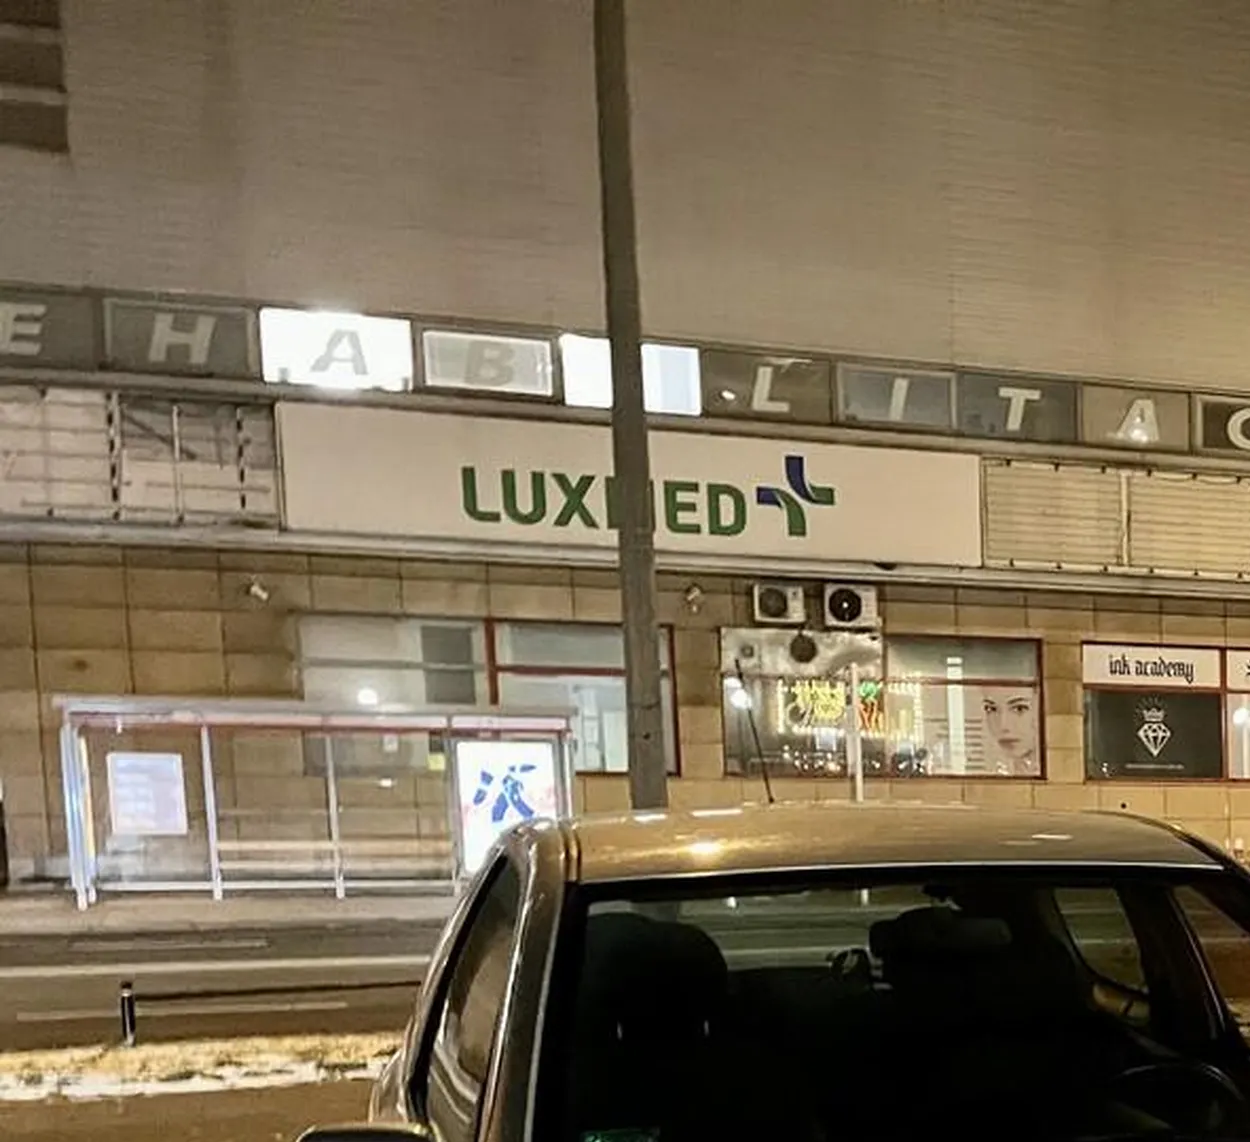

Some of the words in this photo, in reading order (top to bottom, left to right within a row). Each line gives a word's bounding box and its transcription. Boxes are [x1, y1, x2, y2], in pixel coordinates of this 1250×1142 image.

[461, 466, 747, 536] LUXED
[1109, 655, 1130, 676] ink
[1135, 656, 1195, 684] academy
